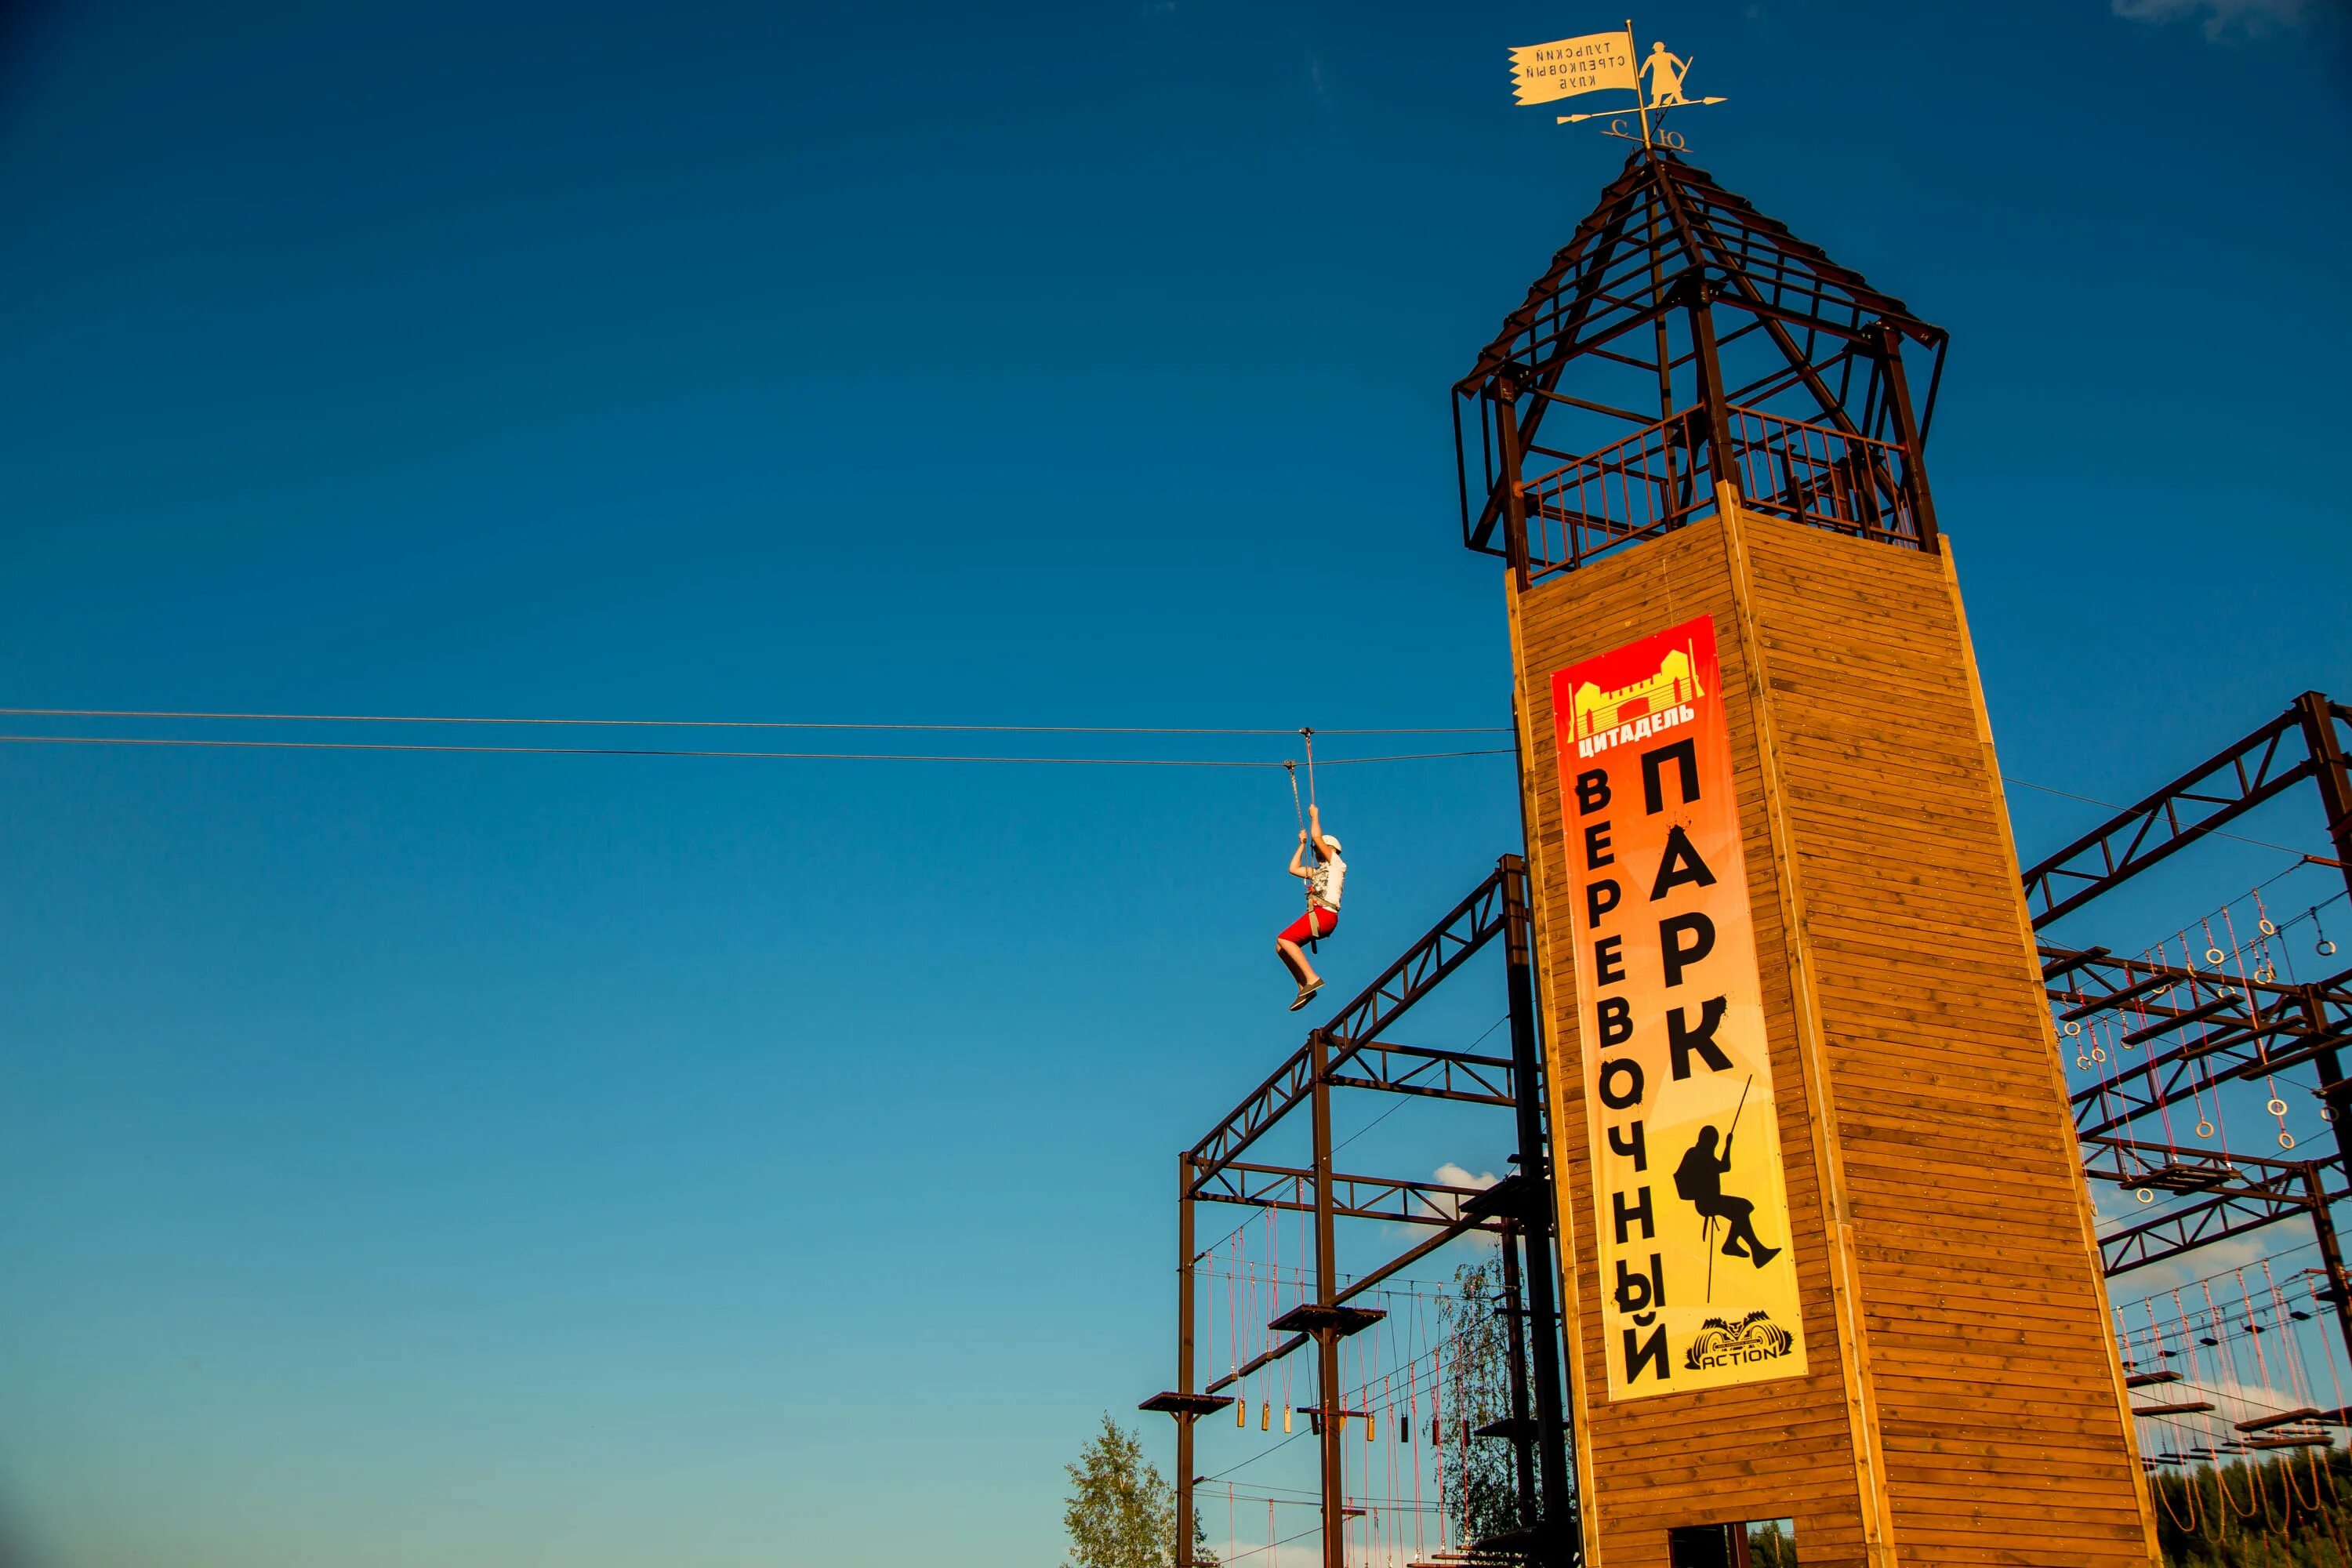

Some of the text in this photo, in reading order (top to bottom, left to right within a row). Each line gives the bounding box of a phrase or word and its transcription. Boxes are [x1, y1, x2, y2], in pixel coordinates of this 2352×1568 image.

[1578, 704, 1695, 759] ЦИТАДЕЛЬ
[1640, 737, 1734, 1082] ПАРК
[1574, 768, 1671, 1385] ВЕРЕВОЧНЫЙ
[1702, 1345, 1778, 1370] ACTION
